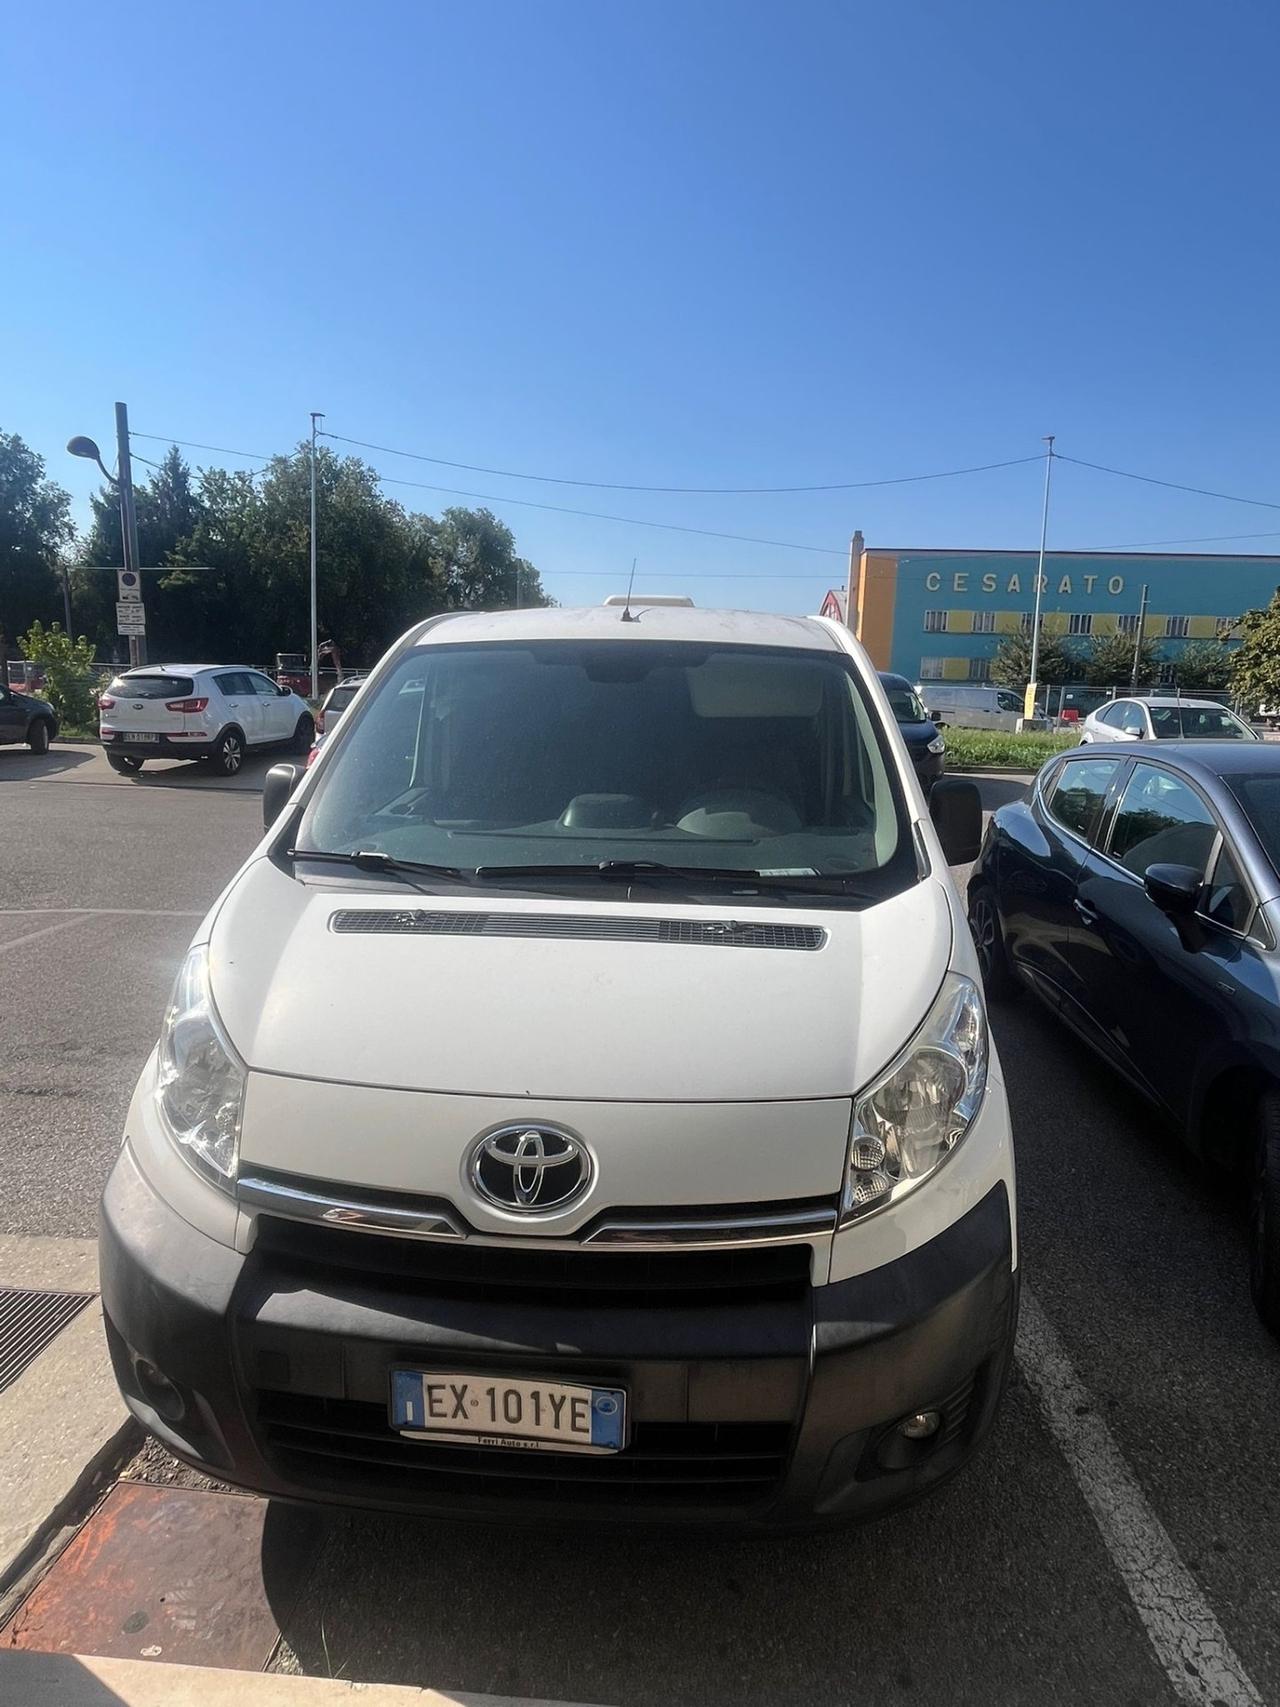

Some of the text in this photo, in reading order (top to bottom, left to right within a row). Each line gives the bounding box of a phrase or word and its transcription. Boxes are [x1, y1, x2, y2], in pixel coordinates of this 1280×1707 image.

[926, 572, 1124, 595] CESARATO
[427, 1384, 590, 1433] EX 101YE
[501, 1438, 521, 1448] Auto
